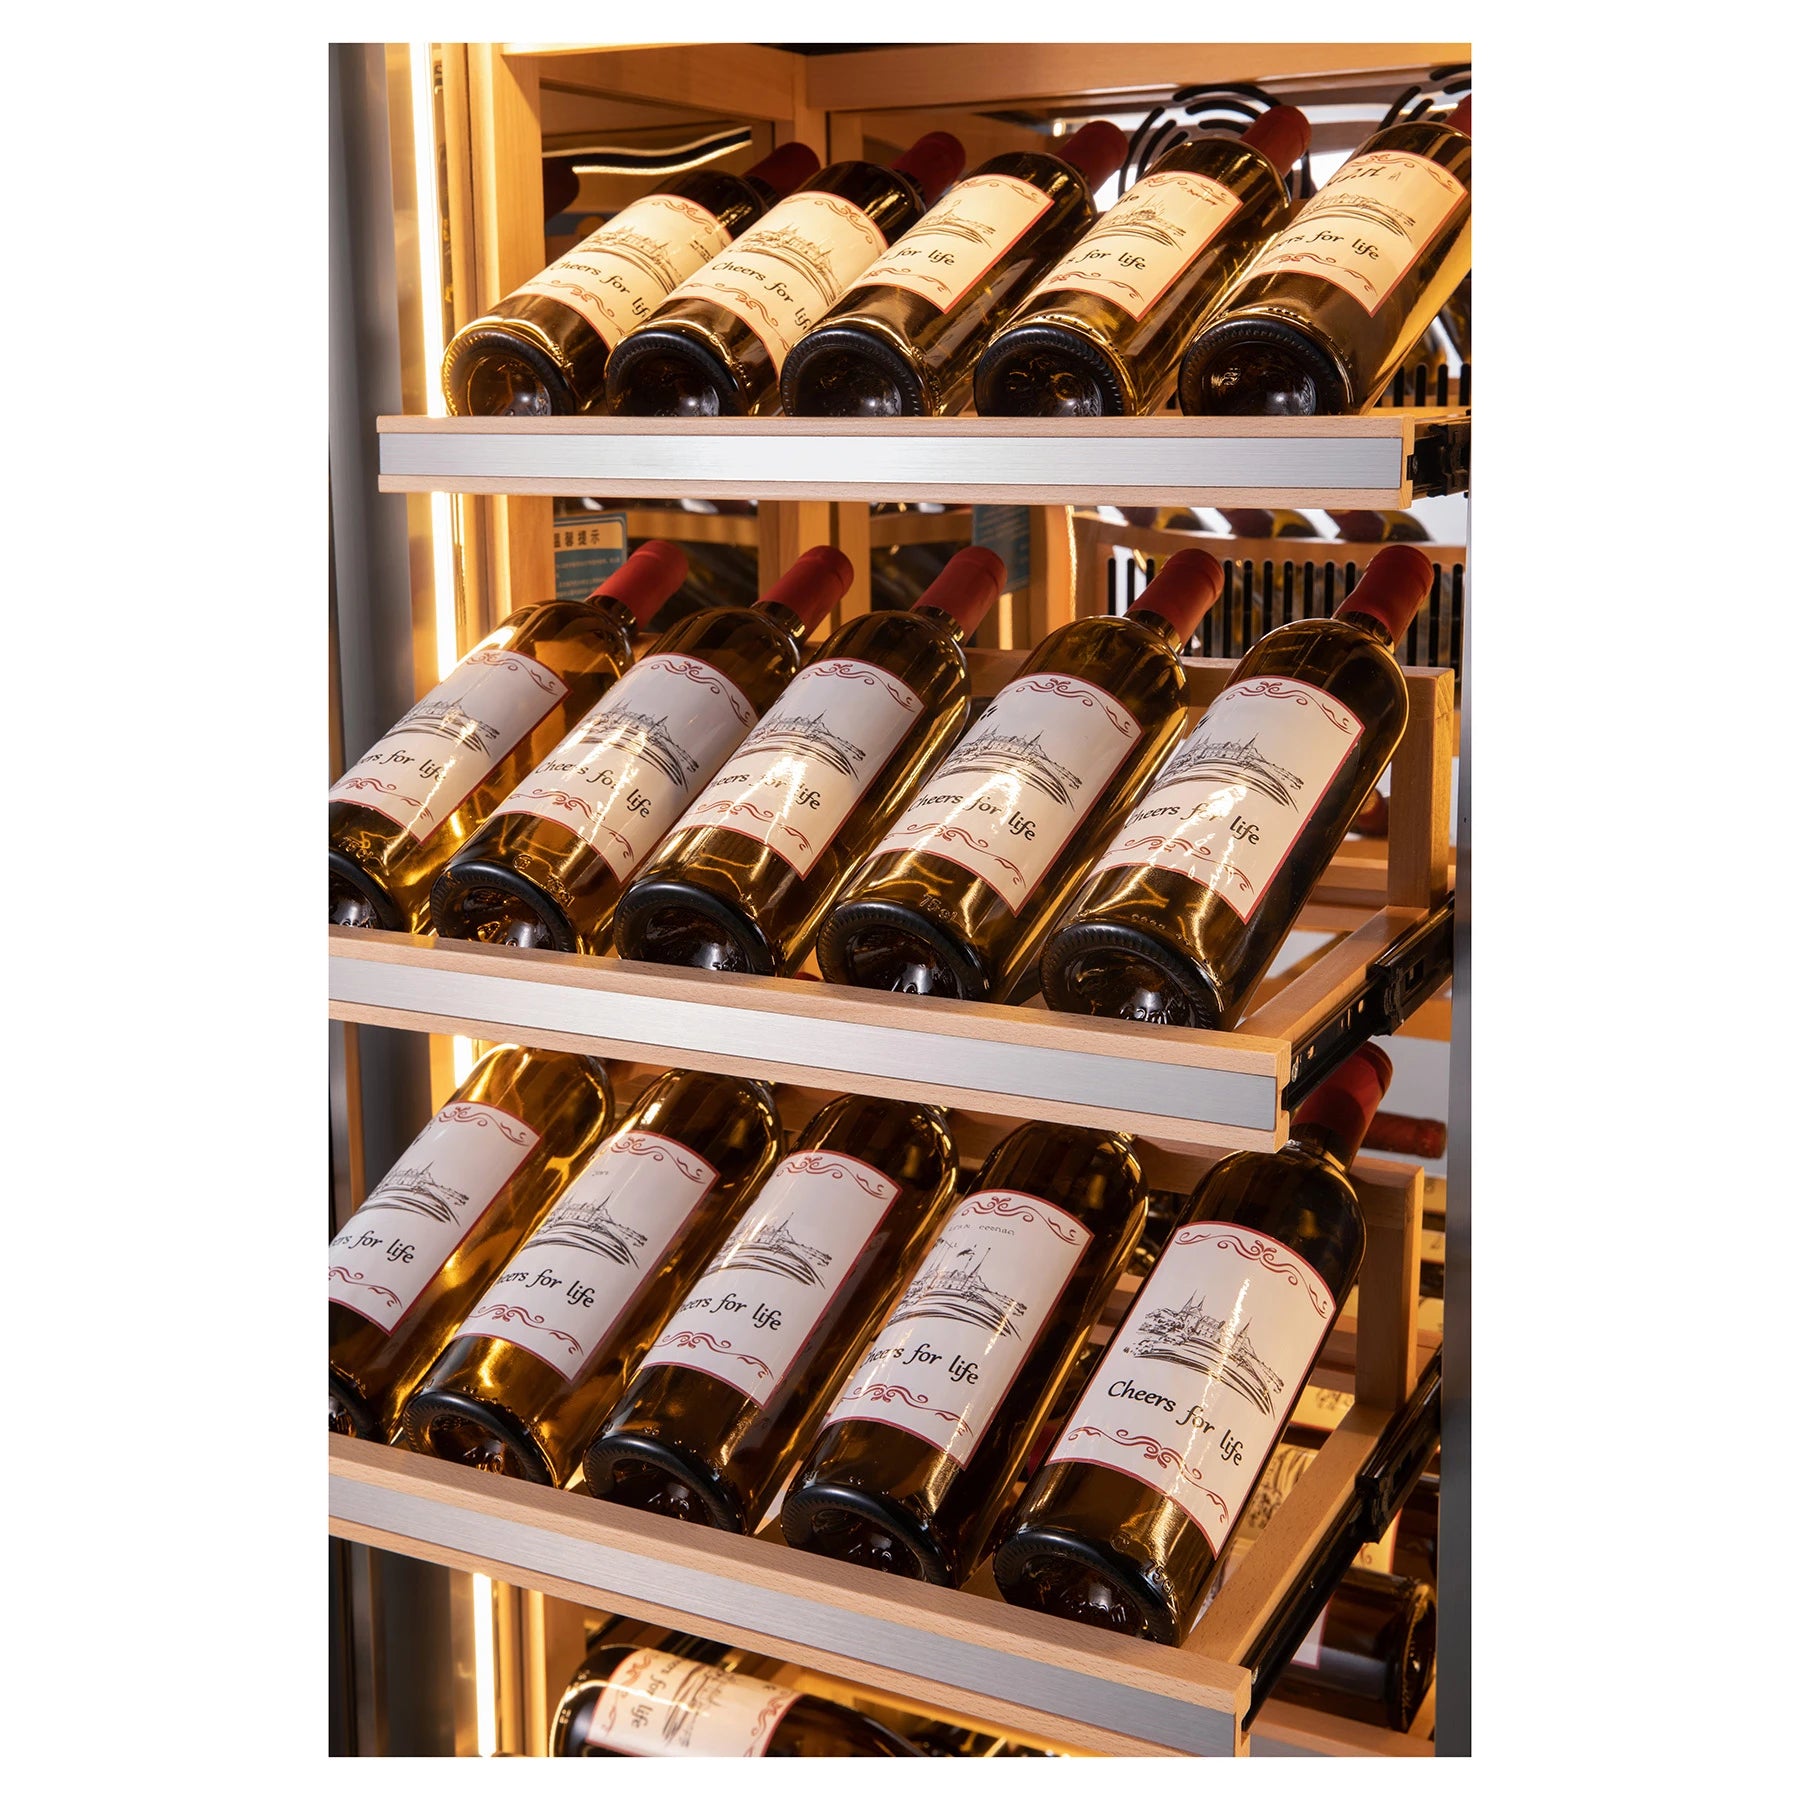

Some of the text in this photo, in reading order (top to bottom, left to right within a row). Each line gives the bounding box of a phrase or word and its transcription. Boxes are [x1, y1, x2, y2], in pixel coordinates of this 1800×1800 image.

[888, 248, 922, 261] for
[927, 249, 956, 266] life
[1074, 249, 1112, 264] for
[1117, 252, 1147, 270] life
[1305, 230, 1345, 243] for
[1351, 238, 1380, 261] life
[599, 275, 631, 294] for
[711, 261, 766, 281] Cheers
[763, 282, 794, 303] for
[378, 749, 415, 765] for
[626, 788, 652, 818] life
[906, 794, 1036, 841] Cheers for life
[1123, 806, 1181, 830] Cheers
[1229, 815, 1260, 845] life
[347, 1230, 383, 1249] for
[386, 1238, 416, 1264] life
[525, 1268, 563, 1289] for
[566, 1280, 596, 1308] life
[708, 1292, 748, 1313] for
[751, 1302, 783, 1331] life
[902, 1343, 943, 1365] for
[948, 1354, 980, 1385] life
[1107, 1379, 1245, 1466] Cheers for life
[630, 1703, 654, 1729] life
